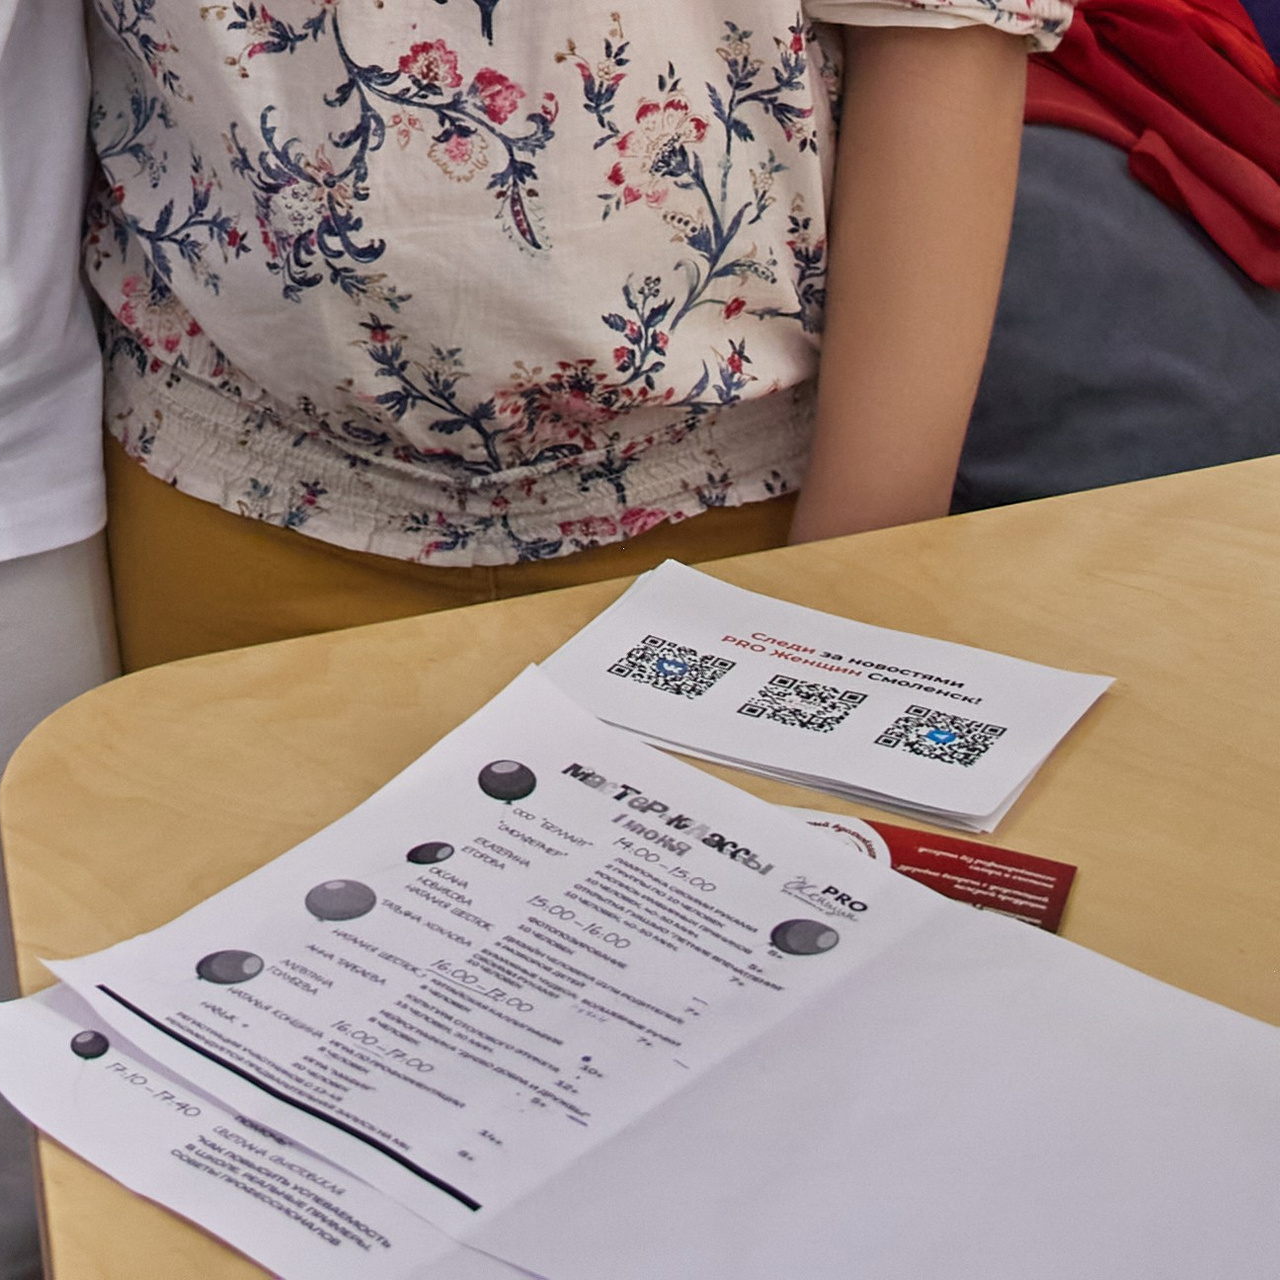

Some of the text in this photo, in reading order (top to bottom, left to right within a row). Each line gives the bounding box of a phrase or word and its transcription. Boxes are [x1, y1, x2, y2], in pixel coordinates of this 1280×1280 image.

[721, 635, 982, 705] PRO Женщин Смоленск!
[751, 632, 964, 688] Следи за новостями
[594, 870, 640, 896] РОСПИСЬ
[573, 883, 625, 911] ОТКРЫТКА
[612, 867, 652, 889] ГРУППЫ
[650, 887, 667, 898] ПО
[666, 895, 681, 905] 10
[680, 902, 725, 928] ЧЕЛОВЕК
[668, 886, 715, 911] СВОИМИ
[714, 909, 758, 933] РУКАМИ
[821, 885, 868, 913] PRO
[532, 931, 574, 955] ЧЕЛОВЕК
[480, 965, 523, 989] ЧЕЛОВЕК
[546, 955, 596, 982] ЧЕЛОВЕКА
[429, 988, 471, 1013] ЧЕЛОВЕК
[377, 1021, 420, 1045] ЧЕЛОВЕК
[327, 1050, 370, 1074] ЧЕЛОВЕК
[307, 1069, 349, 1092] ЧЕЛОВЕК
[528, 1083, 540, 1091] И
[170, 1149, 221, 1177] СОВЕТЫ
[184, 1143, 197, 1152] В
[242, 1173, 306, 1208] РЕАЛЬНЫЕ
[224, 1151, 290, 1186] ПОВЫСИТЬ
[293, 1186, 391, 1248] УСПЕВАЕМОСТЬ
